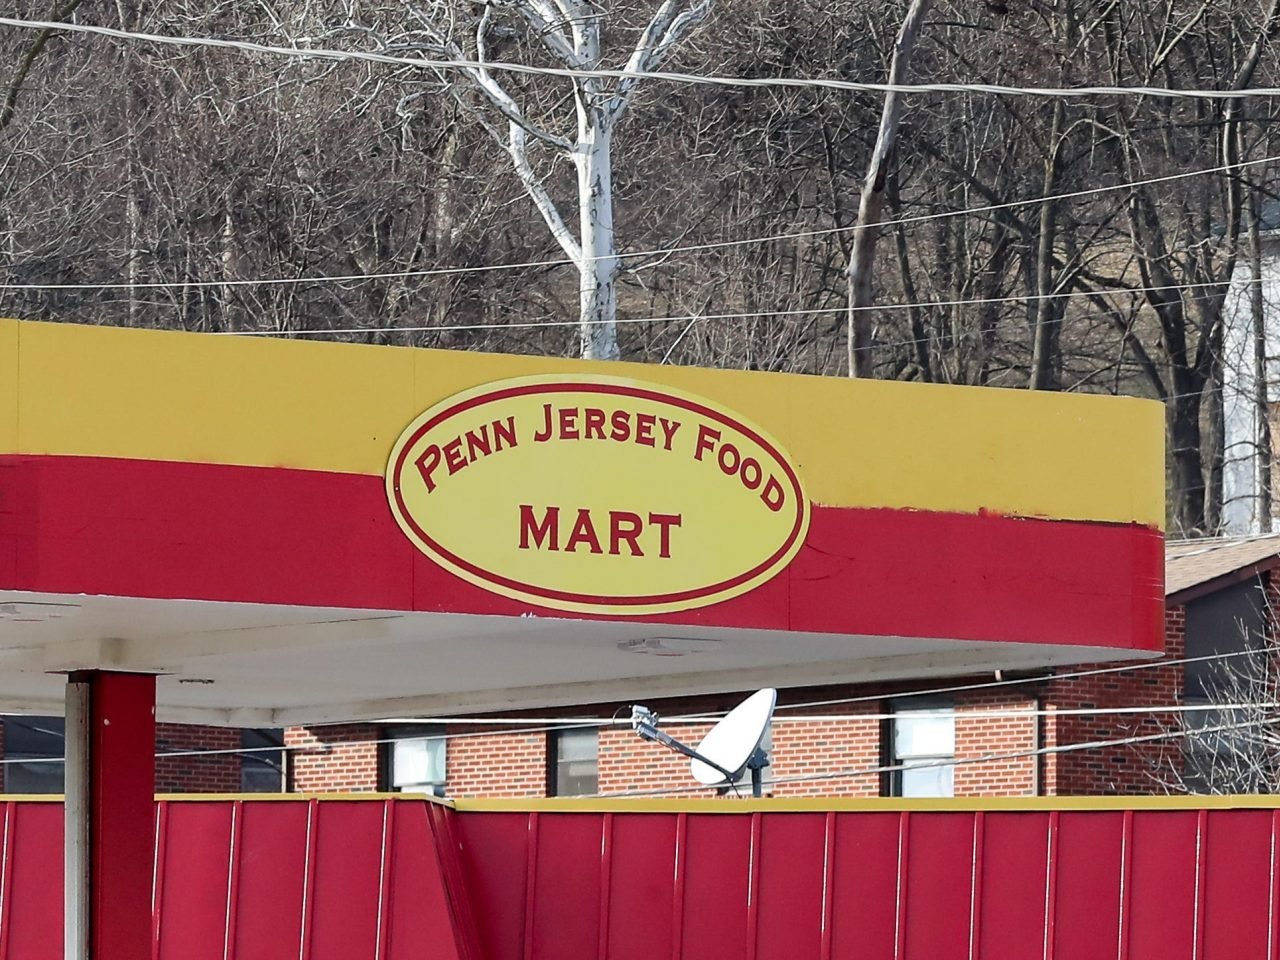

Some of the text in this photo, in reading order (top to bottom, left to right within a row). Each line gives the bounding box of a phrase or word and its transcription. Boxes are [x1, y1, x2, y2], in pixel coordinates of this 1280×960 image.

[414, 404, 786, 512] PENN JERSEY FOOD
[519, 505, 681, 558] MART
